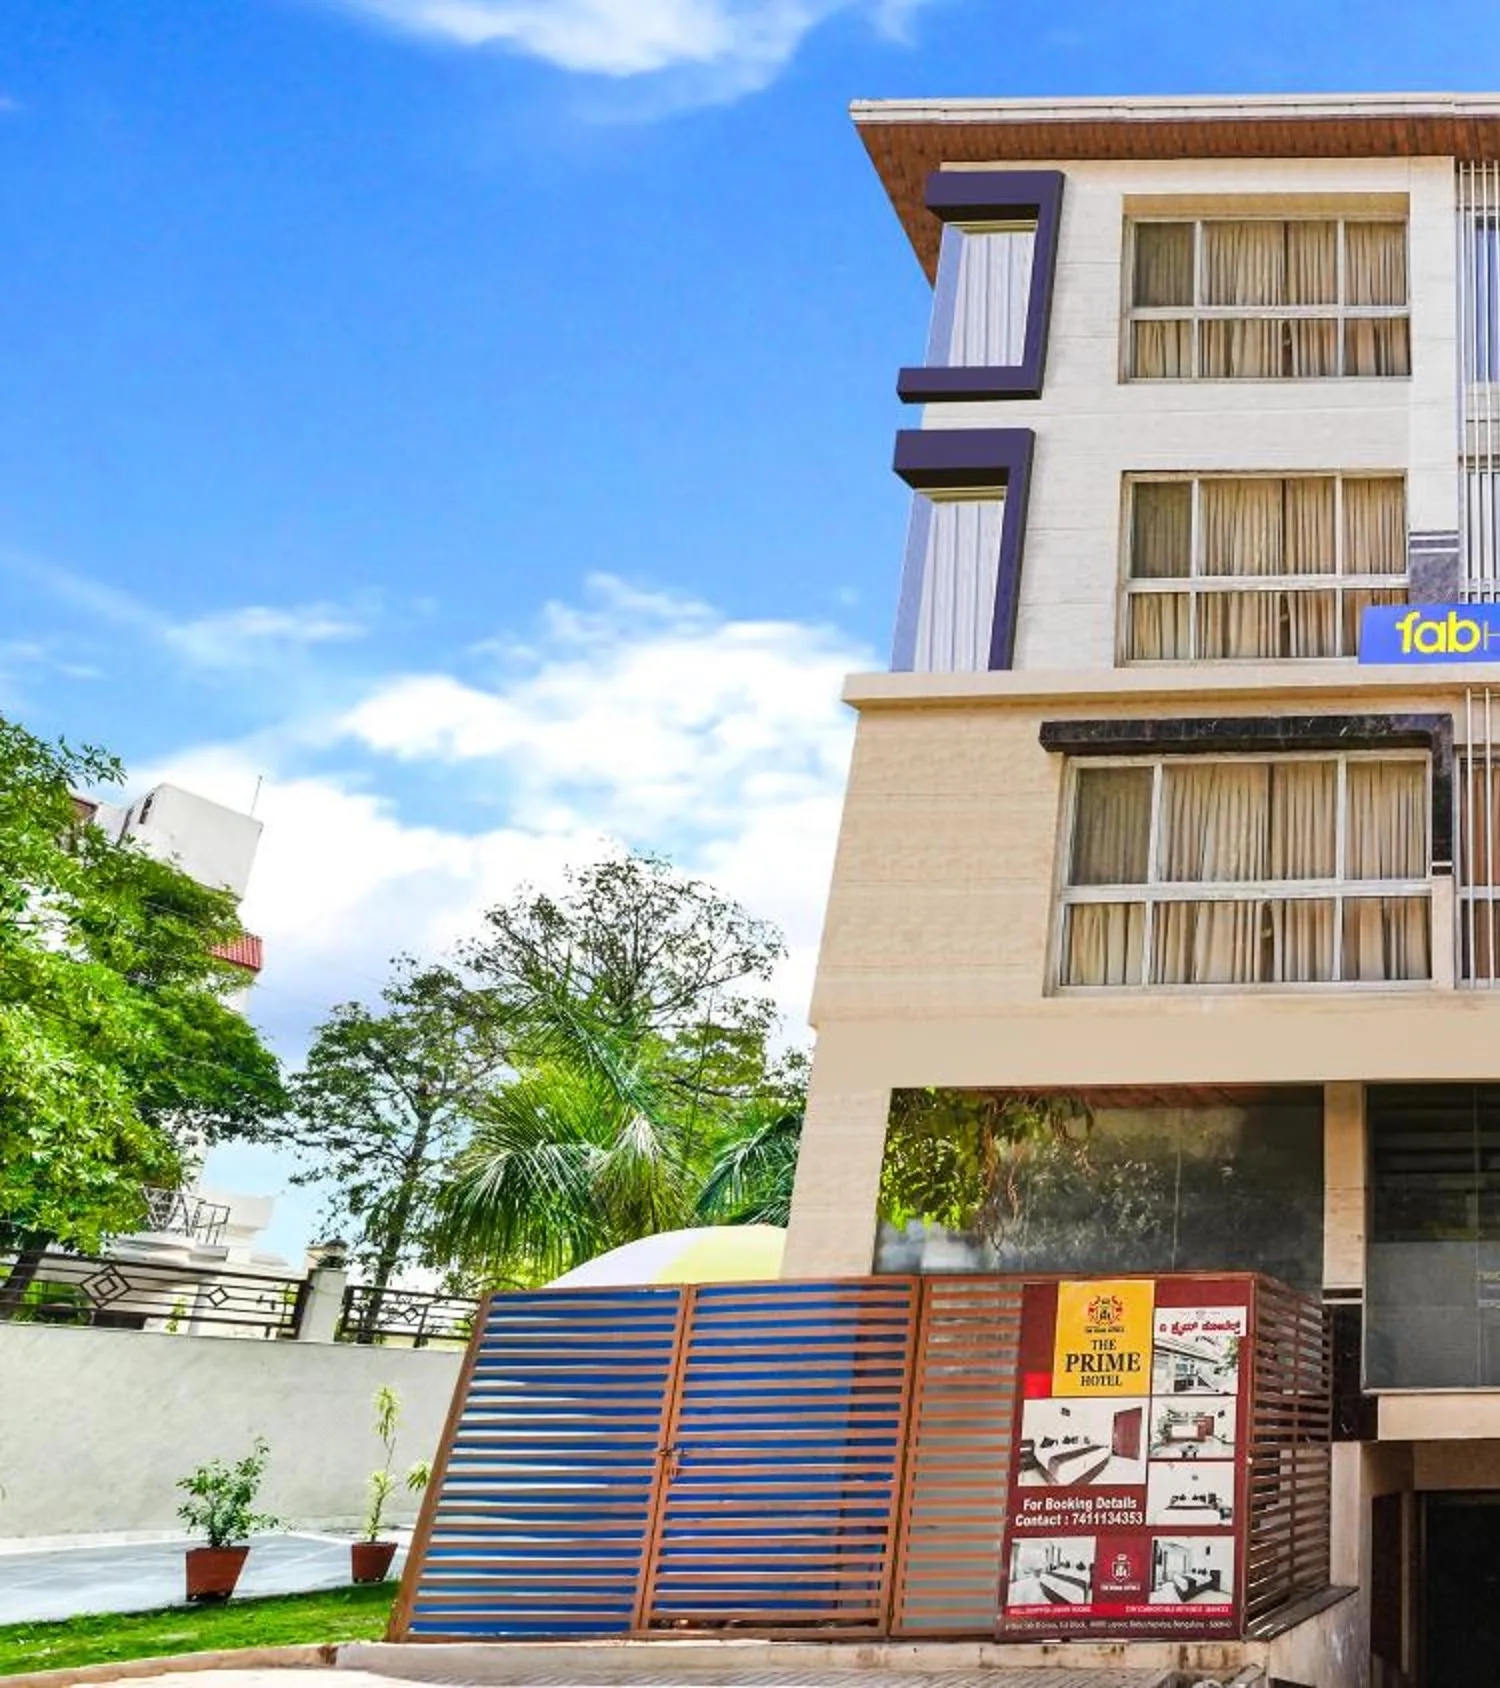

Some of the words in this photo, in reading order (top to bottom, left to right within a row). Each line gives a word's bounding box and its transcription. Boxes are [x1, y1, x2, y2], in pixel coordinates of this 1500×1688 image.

[1091, 1339, 1117, 1351] THE
[1066, 1352, 1141, 1373] PRIME
[1080, 1375, 1123, 1387] HOTEL
[1023, 1499, 1042, 1511] For
[1045, 1497, 1093, 1512] Booking
[1095, 1496, 1137, 1509] Details
[1015, 1513, 1061, 1527] Contact
[1072, 1511, 1143, 1526] 7411134353
